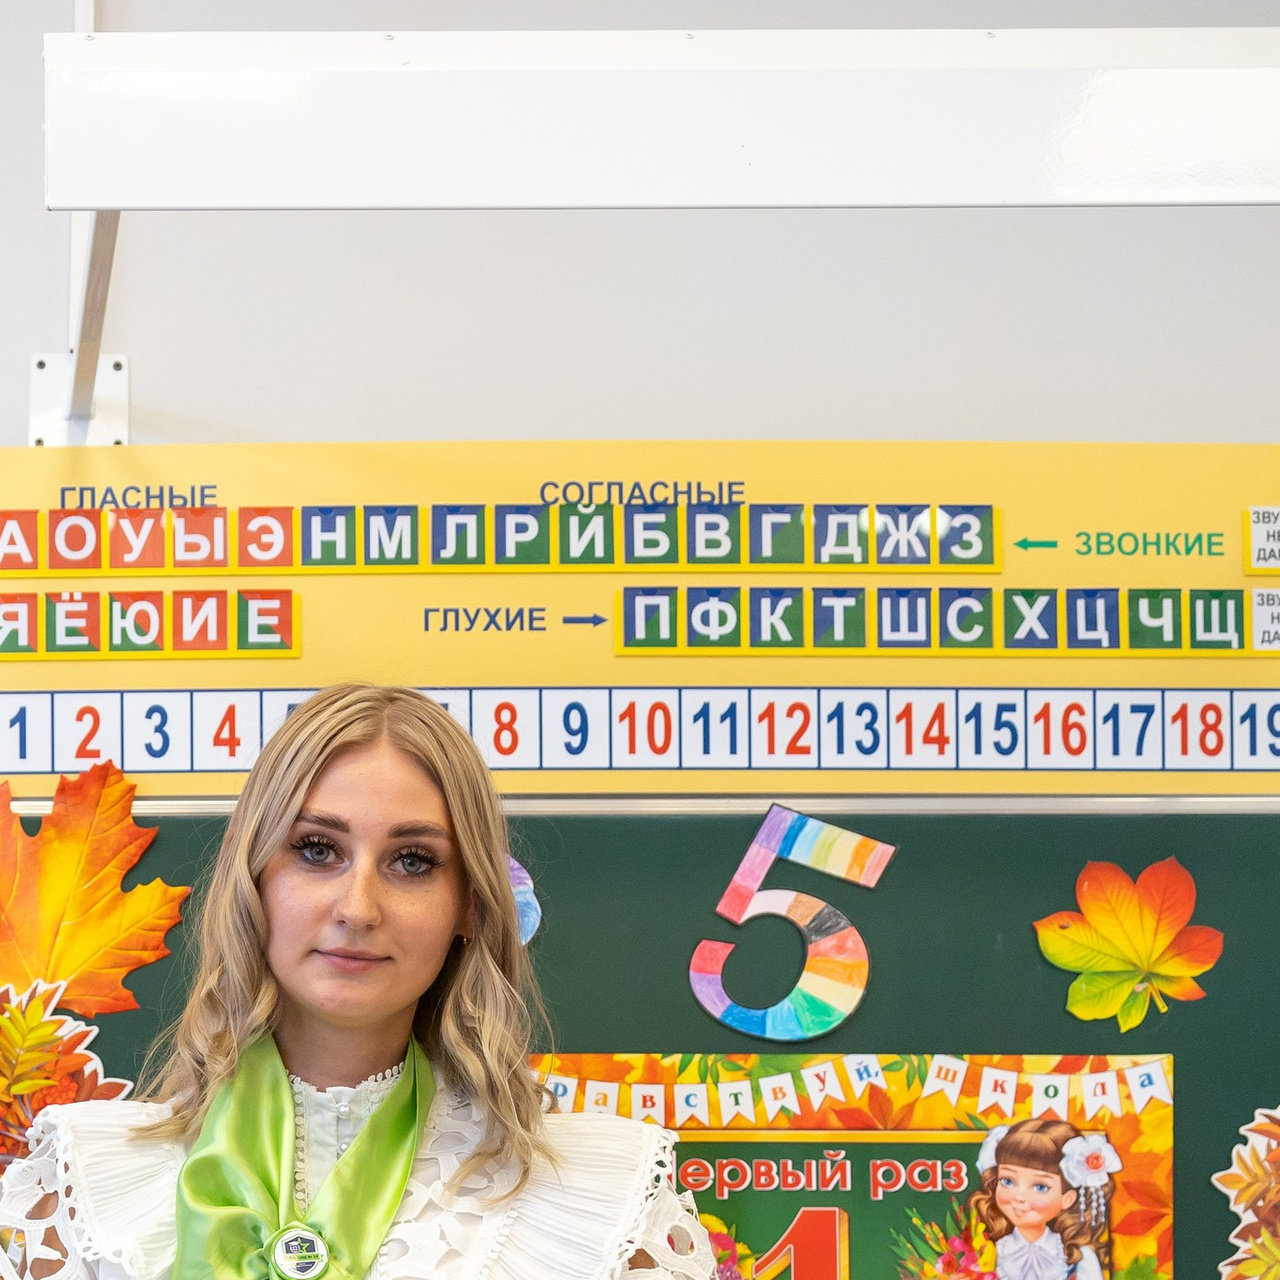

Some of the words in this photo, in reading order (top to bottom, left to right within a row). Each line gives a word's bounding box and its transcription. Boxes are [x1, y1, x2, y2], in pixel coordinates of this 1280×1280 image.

[60, 485, 218, 509] ГЛАСНЫЕ
[540, 481, 745, 505] СОГЛАСНЫЕ
[1075, 532, 1224, 556] ЗВОНКИЕ
[1266, 529, 1280, 542] Н
[1256, 547, 1280, 562] ДА
[424, 607, 547, 632] ГЛУХИЕ
[9, 706, 27, 760] 1
[75, 705, 102, 759] 2
[144, 704, 170, 759] 3
[212, 704, 241, 758] 4
[493, 702, 519, 756] 8
[563, 702, 589, 755] 9
[618, 702, 672, 755] 10
[692, 702, 738, 755] 11
[757, 702, 811, 755] 12
[826, 702, 881, 756] 13
[895, 702, 950, 756] 14
[964, 702, 1019, 756] 15
[1033, 702, 1087, 756] 16
[1102, 703, 1156, 756] 17
[1171, 703, 1224, 757] 18
[668, 1150, 852, 1200] ервый
[870, 1158, 969, 1200] раз
